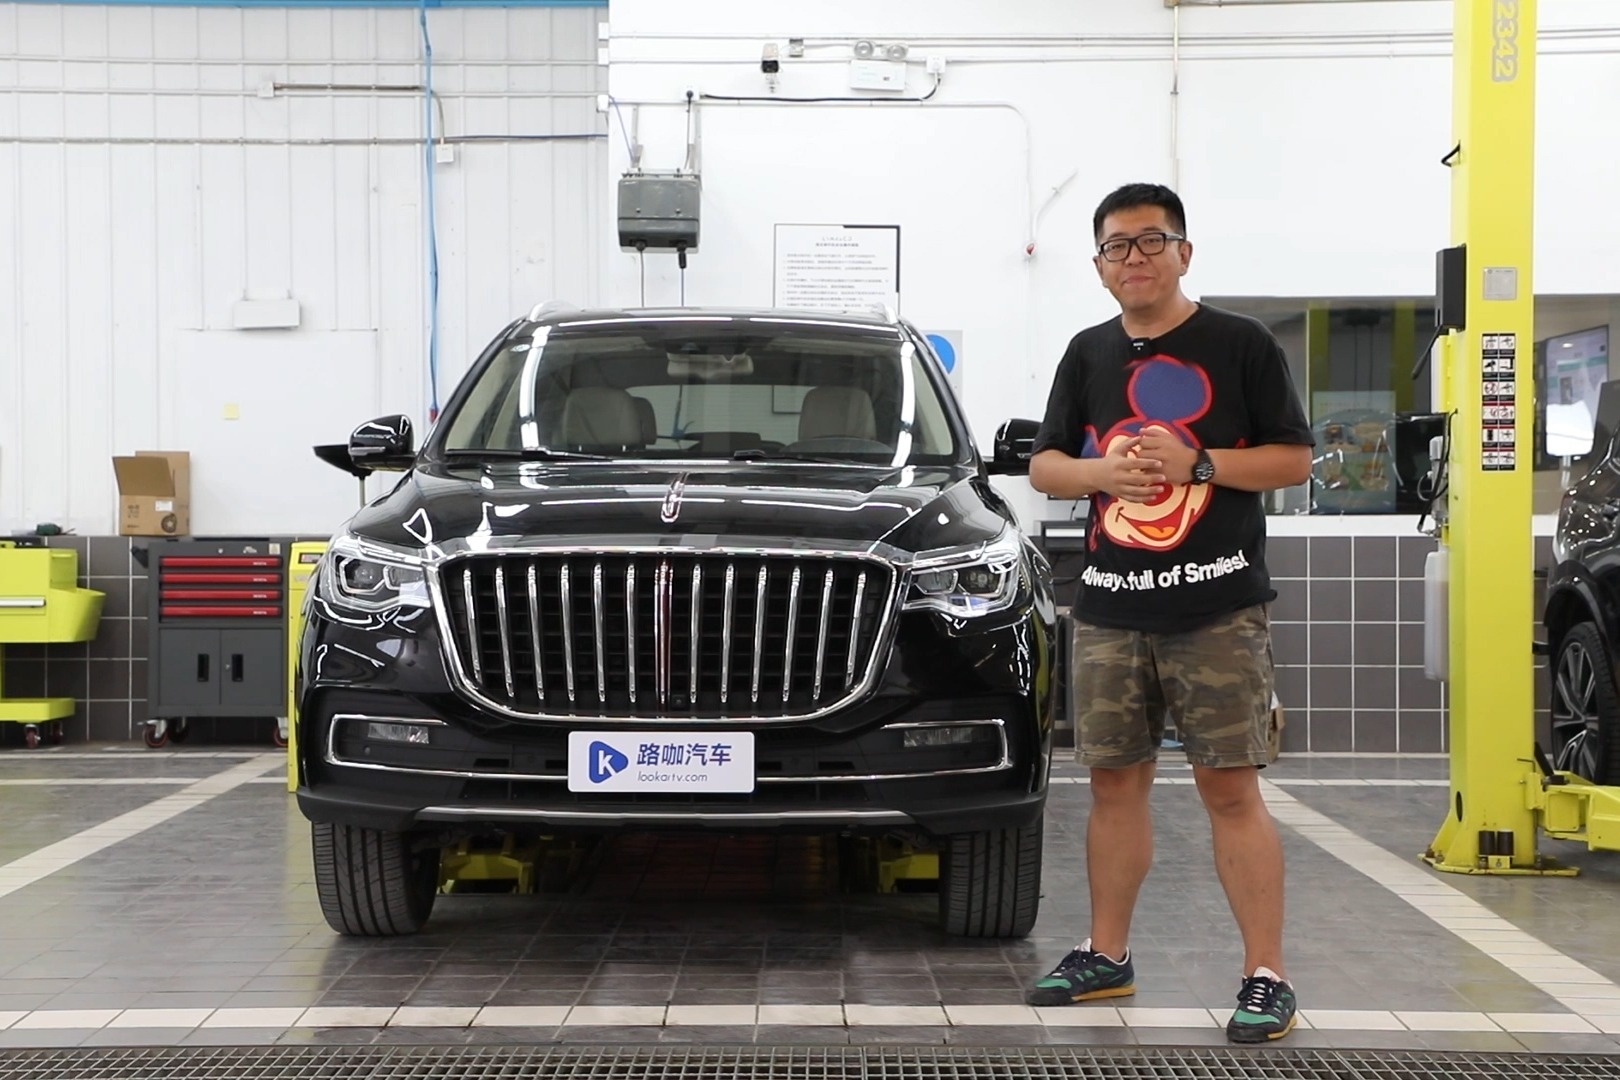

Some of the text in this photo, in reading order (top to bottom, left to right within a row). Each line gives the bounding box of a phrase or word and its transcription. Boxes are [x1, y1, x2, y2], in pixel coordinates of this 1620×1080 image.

[1127, 569, 1155, 591] full
[1157, 565, 1182, 588] of
[1184, 549, 1250, 584] Smiles!
[636, 743, 732, 766] 路咖汽车
[637, 771, 708, 782] lookartv.com
